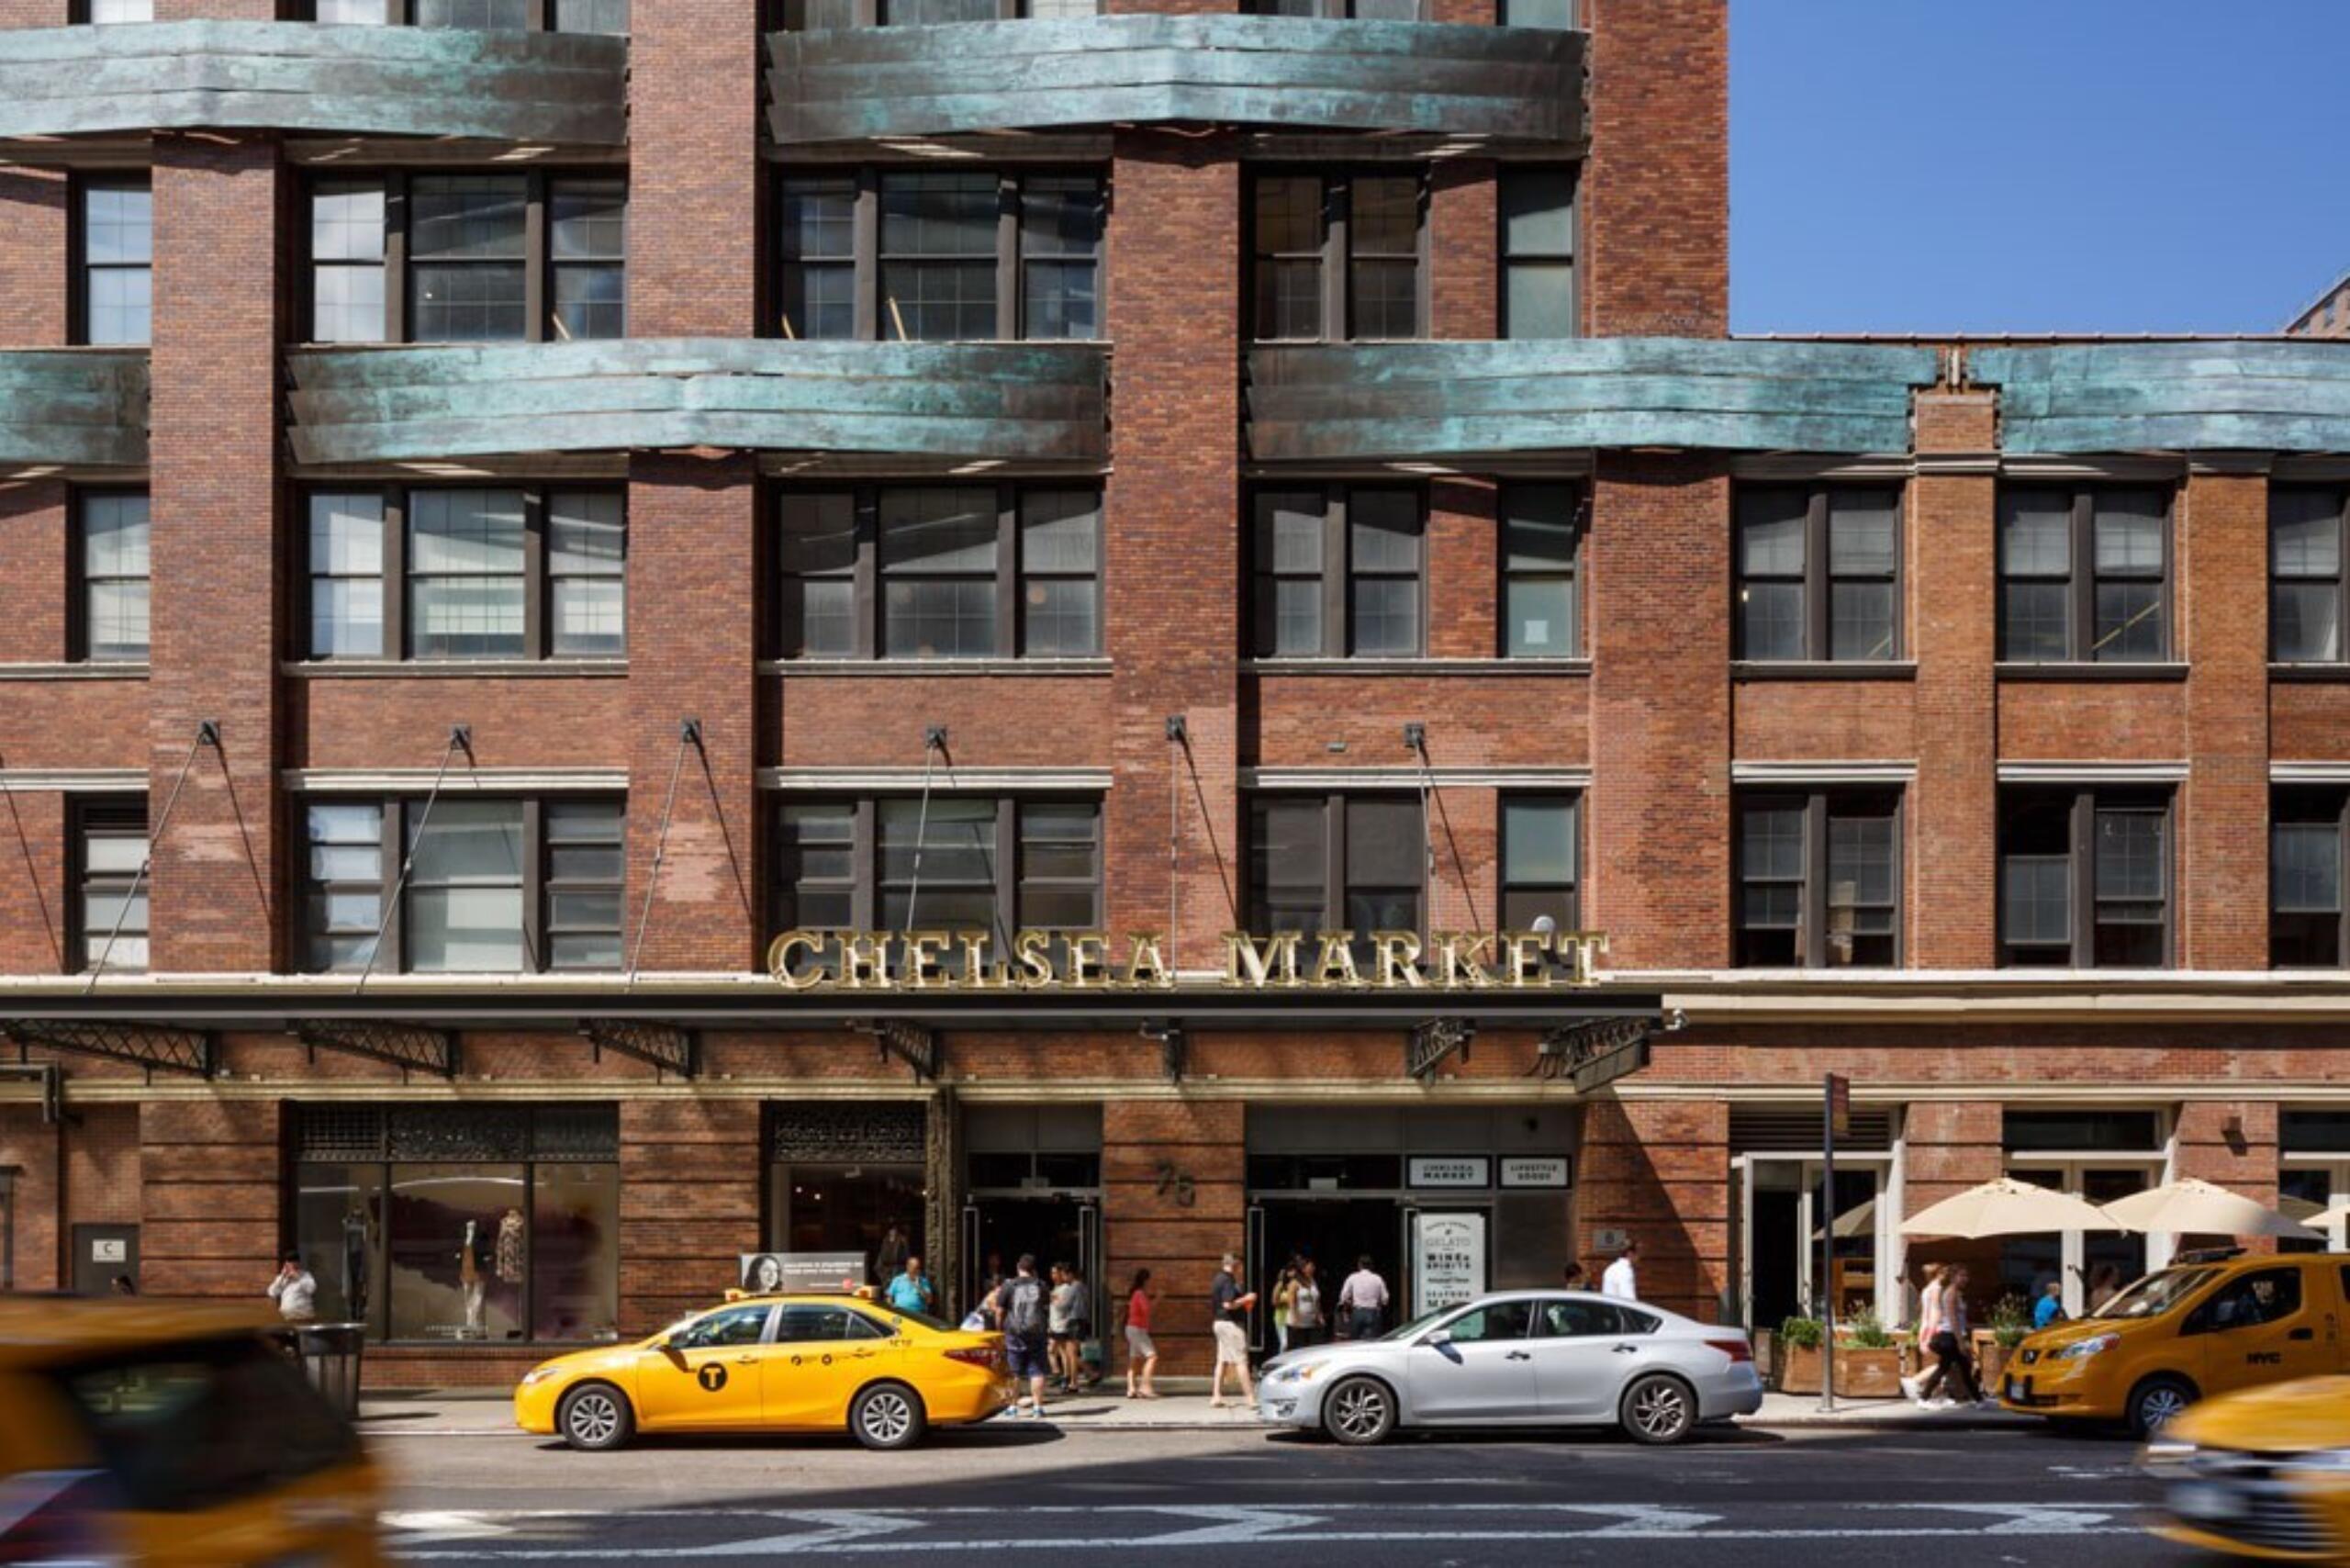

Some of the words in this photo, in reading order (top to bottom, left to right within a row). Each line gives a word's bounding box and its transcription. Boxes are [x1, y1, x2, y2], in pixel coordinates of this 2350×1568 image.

[767, 930, 1174, 989] CHELSEA
[1219, 930, 1610, 989] MARKET
[2246, 1351, 2280, 1364] NYC
[703, 1367, 722, 1388] T
